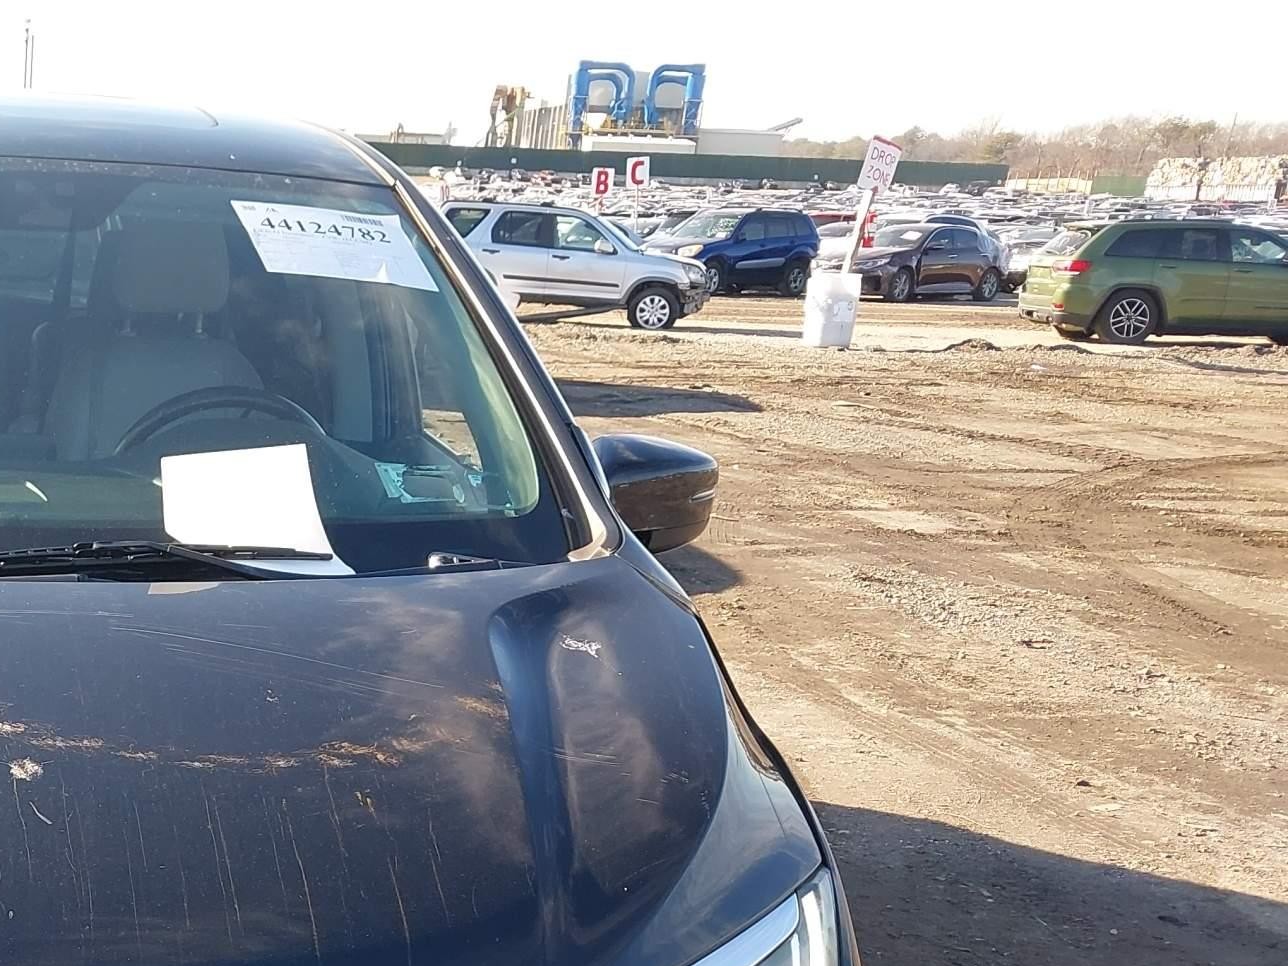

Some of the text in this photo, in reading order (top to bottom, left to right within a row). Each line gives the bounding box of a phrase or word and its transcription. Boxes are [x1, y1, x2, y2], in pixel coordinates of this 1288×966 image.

[870, 146, 897, 168] DROP
[595, 170, 609, 195] B
[631, 160, 645, 185] C
[865, 165, 891, 187] ZONE
[261, 217, 392, 244] 44124782
